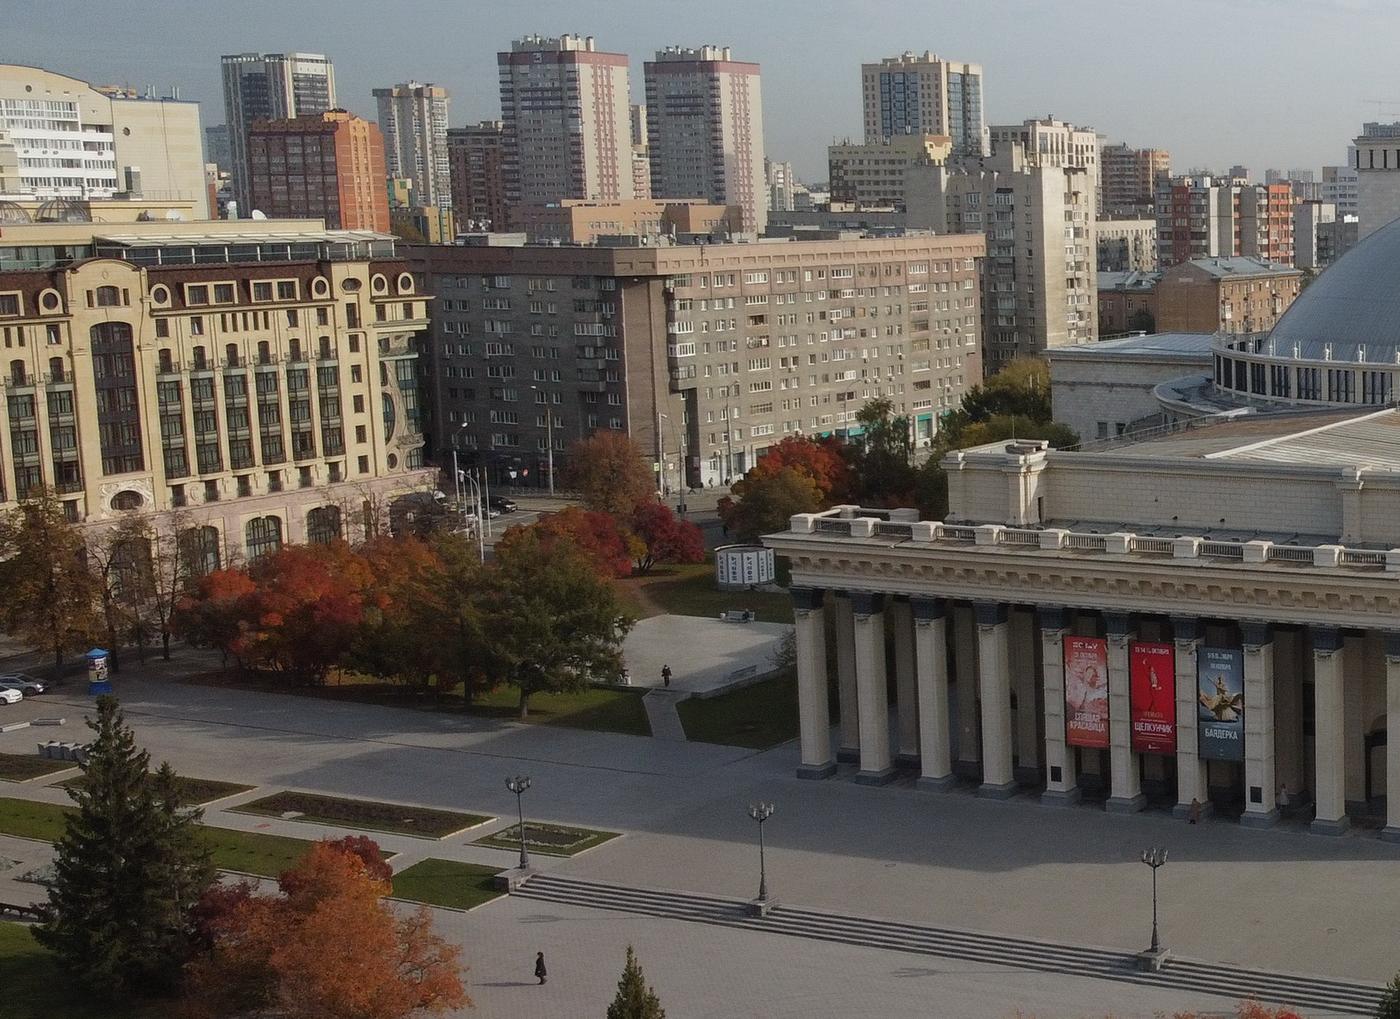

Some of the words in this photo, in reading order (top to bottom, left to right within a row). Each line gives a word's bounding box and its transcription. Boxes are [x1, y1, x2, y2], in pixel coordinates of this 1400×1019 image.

[1069, 721, 1105, 733] КРАСАВИЦА
[1134, 722, 1172, 733] ЩЕЛКУНЧИК
[1204, 728, 1238, 740] БАЯДЕРКА
